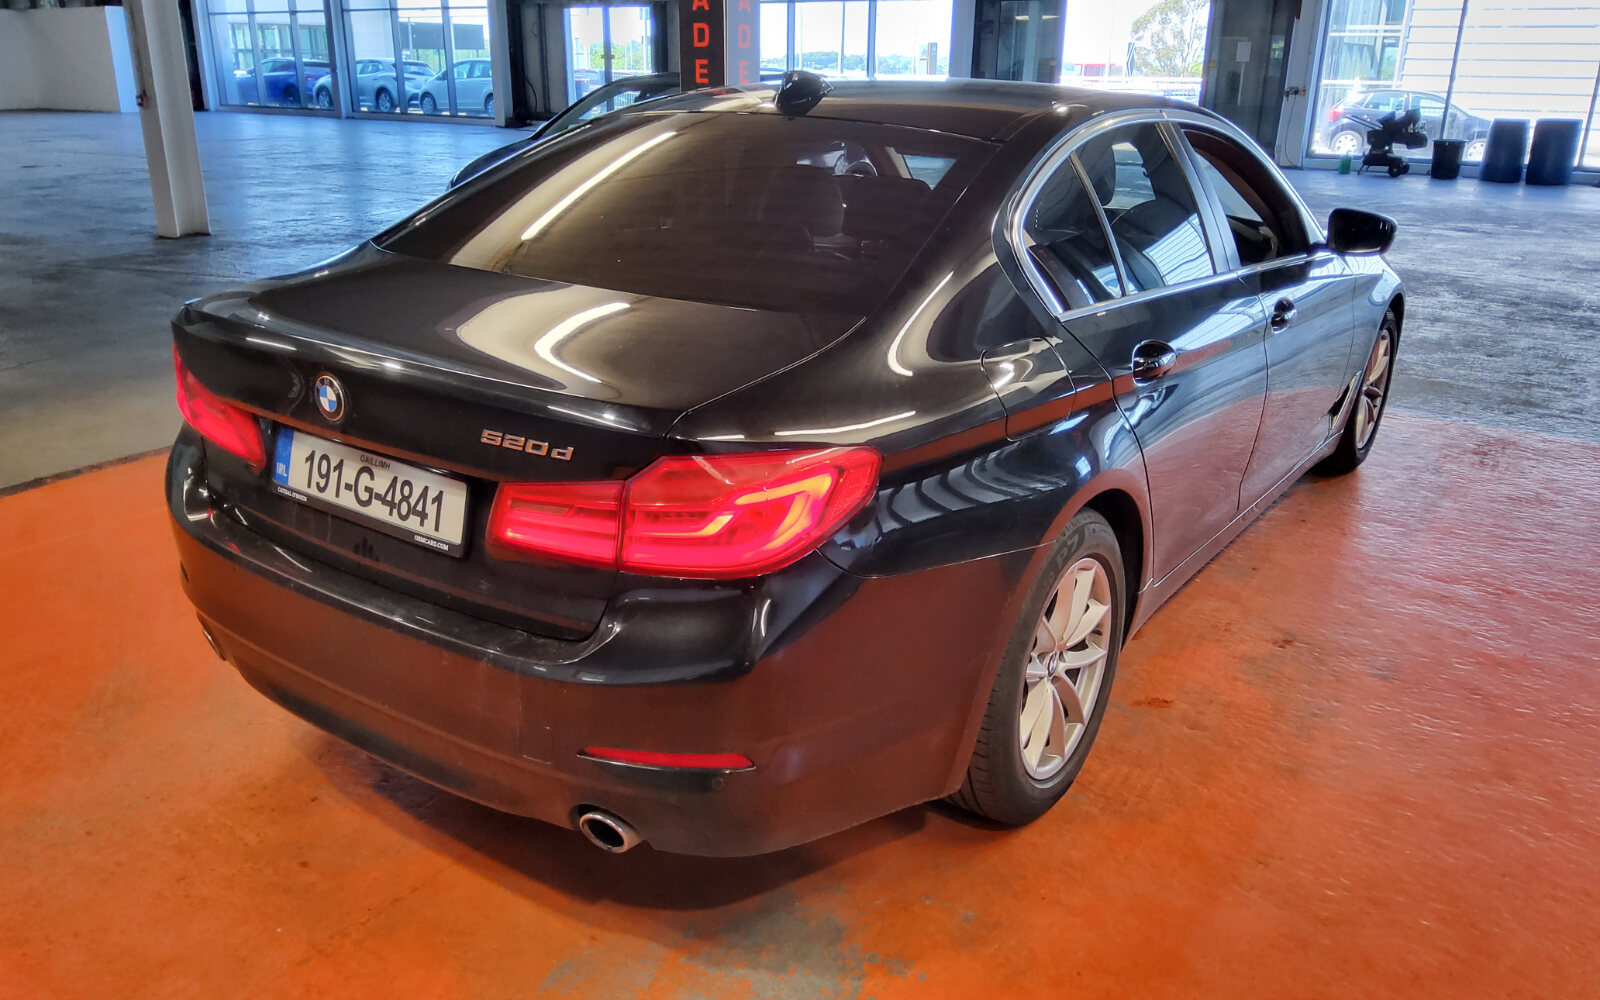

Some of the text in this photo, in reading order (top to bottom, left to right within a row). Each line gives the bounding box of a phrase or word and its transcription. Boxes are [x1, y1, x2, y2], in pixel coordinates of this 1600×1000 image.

[480, 429, 575, 461] 520d
[276, 462, 288, 477] IRL
[360, 454, 391, 471] GAILLIMH
[305, 449, 444, 533] 191-G-4841
